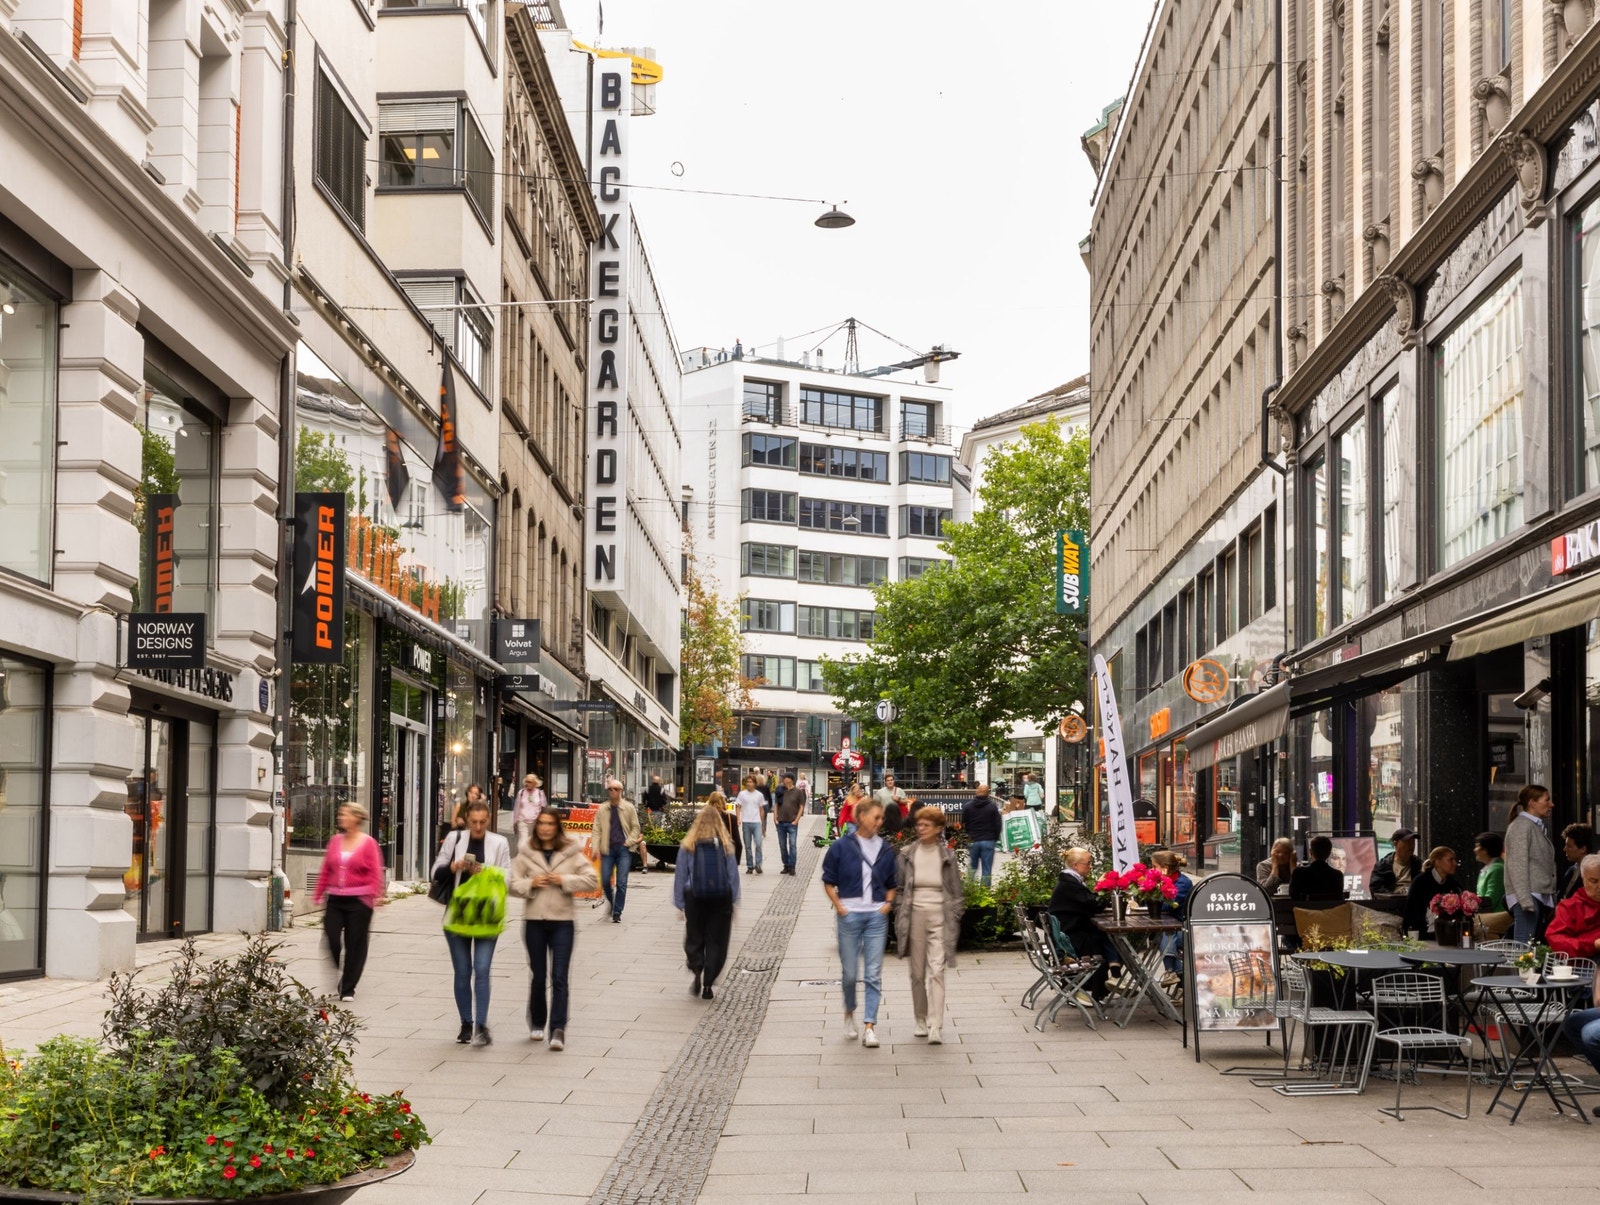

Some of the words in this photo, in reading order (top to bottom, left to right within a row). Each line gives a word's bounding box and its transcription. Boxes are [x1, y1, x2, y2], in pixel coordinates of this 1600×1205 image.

[1565, 520, 1600, 570] BAK
[316, 505, 335, 649] POWER
[1062, 533, 1080, 611] SUBWAY
[137, 622, 195, 635] NORWAY
[137, 637, 193, 649] DESIGNS
[505, 640, 533, 648] Volvat
[413, 644, 432, 674] POWER
[924, 801, 963, 811] tortinget
[561, 822, 593, 831] RSDAGS
[1204, 1008, 1222, 1018] NÅ
[1224, 1008, 1240, 1018] KR
[1244, 1008, 1256, 1018] 35
